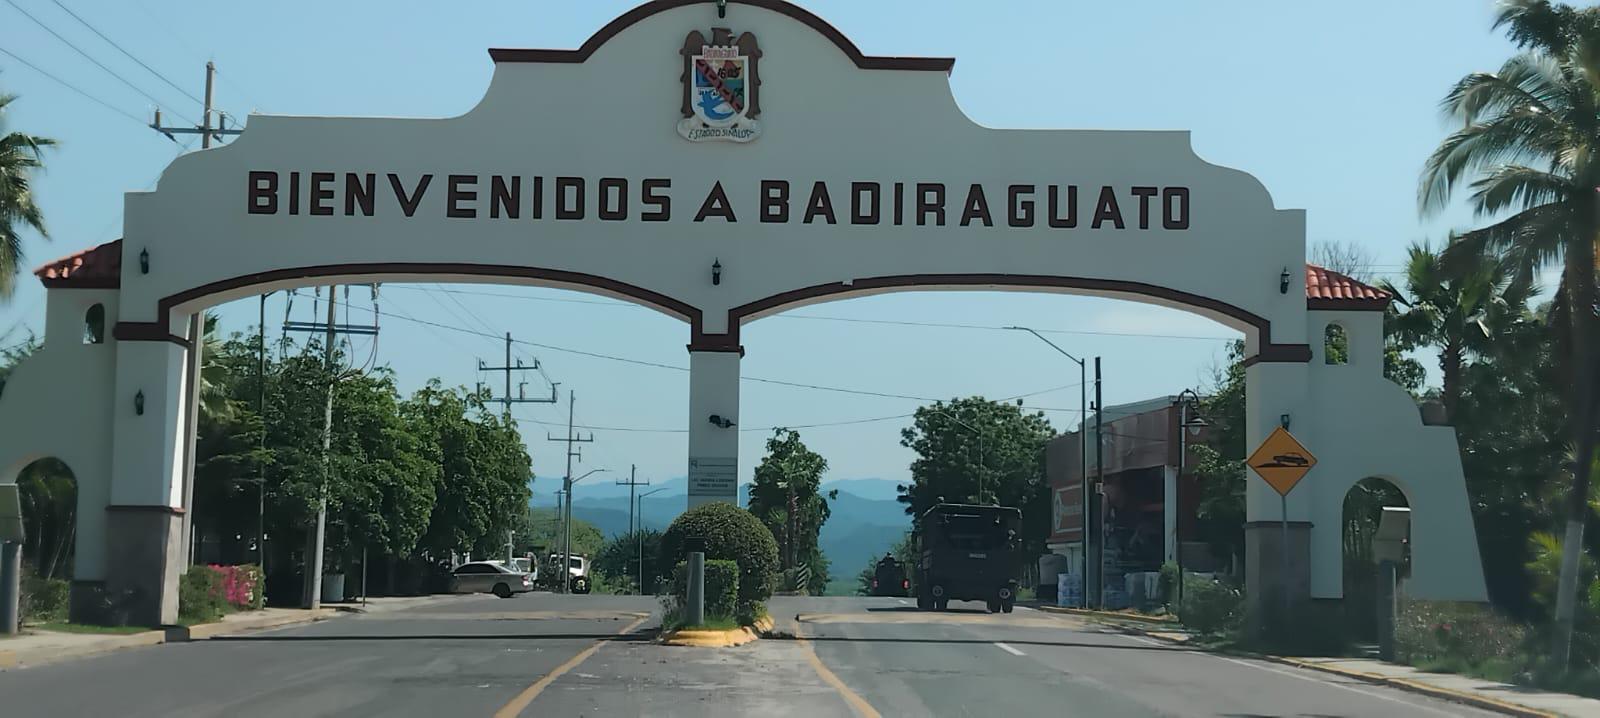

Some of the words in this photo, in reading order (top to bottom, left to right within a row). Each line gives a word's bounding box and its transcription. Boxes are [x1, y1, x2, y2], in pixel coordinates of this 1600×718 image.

[248, 170, 672, 223] BIENVENIDOS
[693, 180, 738, 224] A
[759, 179, 1190, 231] BADIRAGUATO
